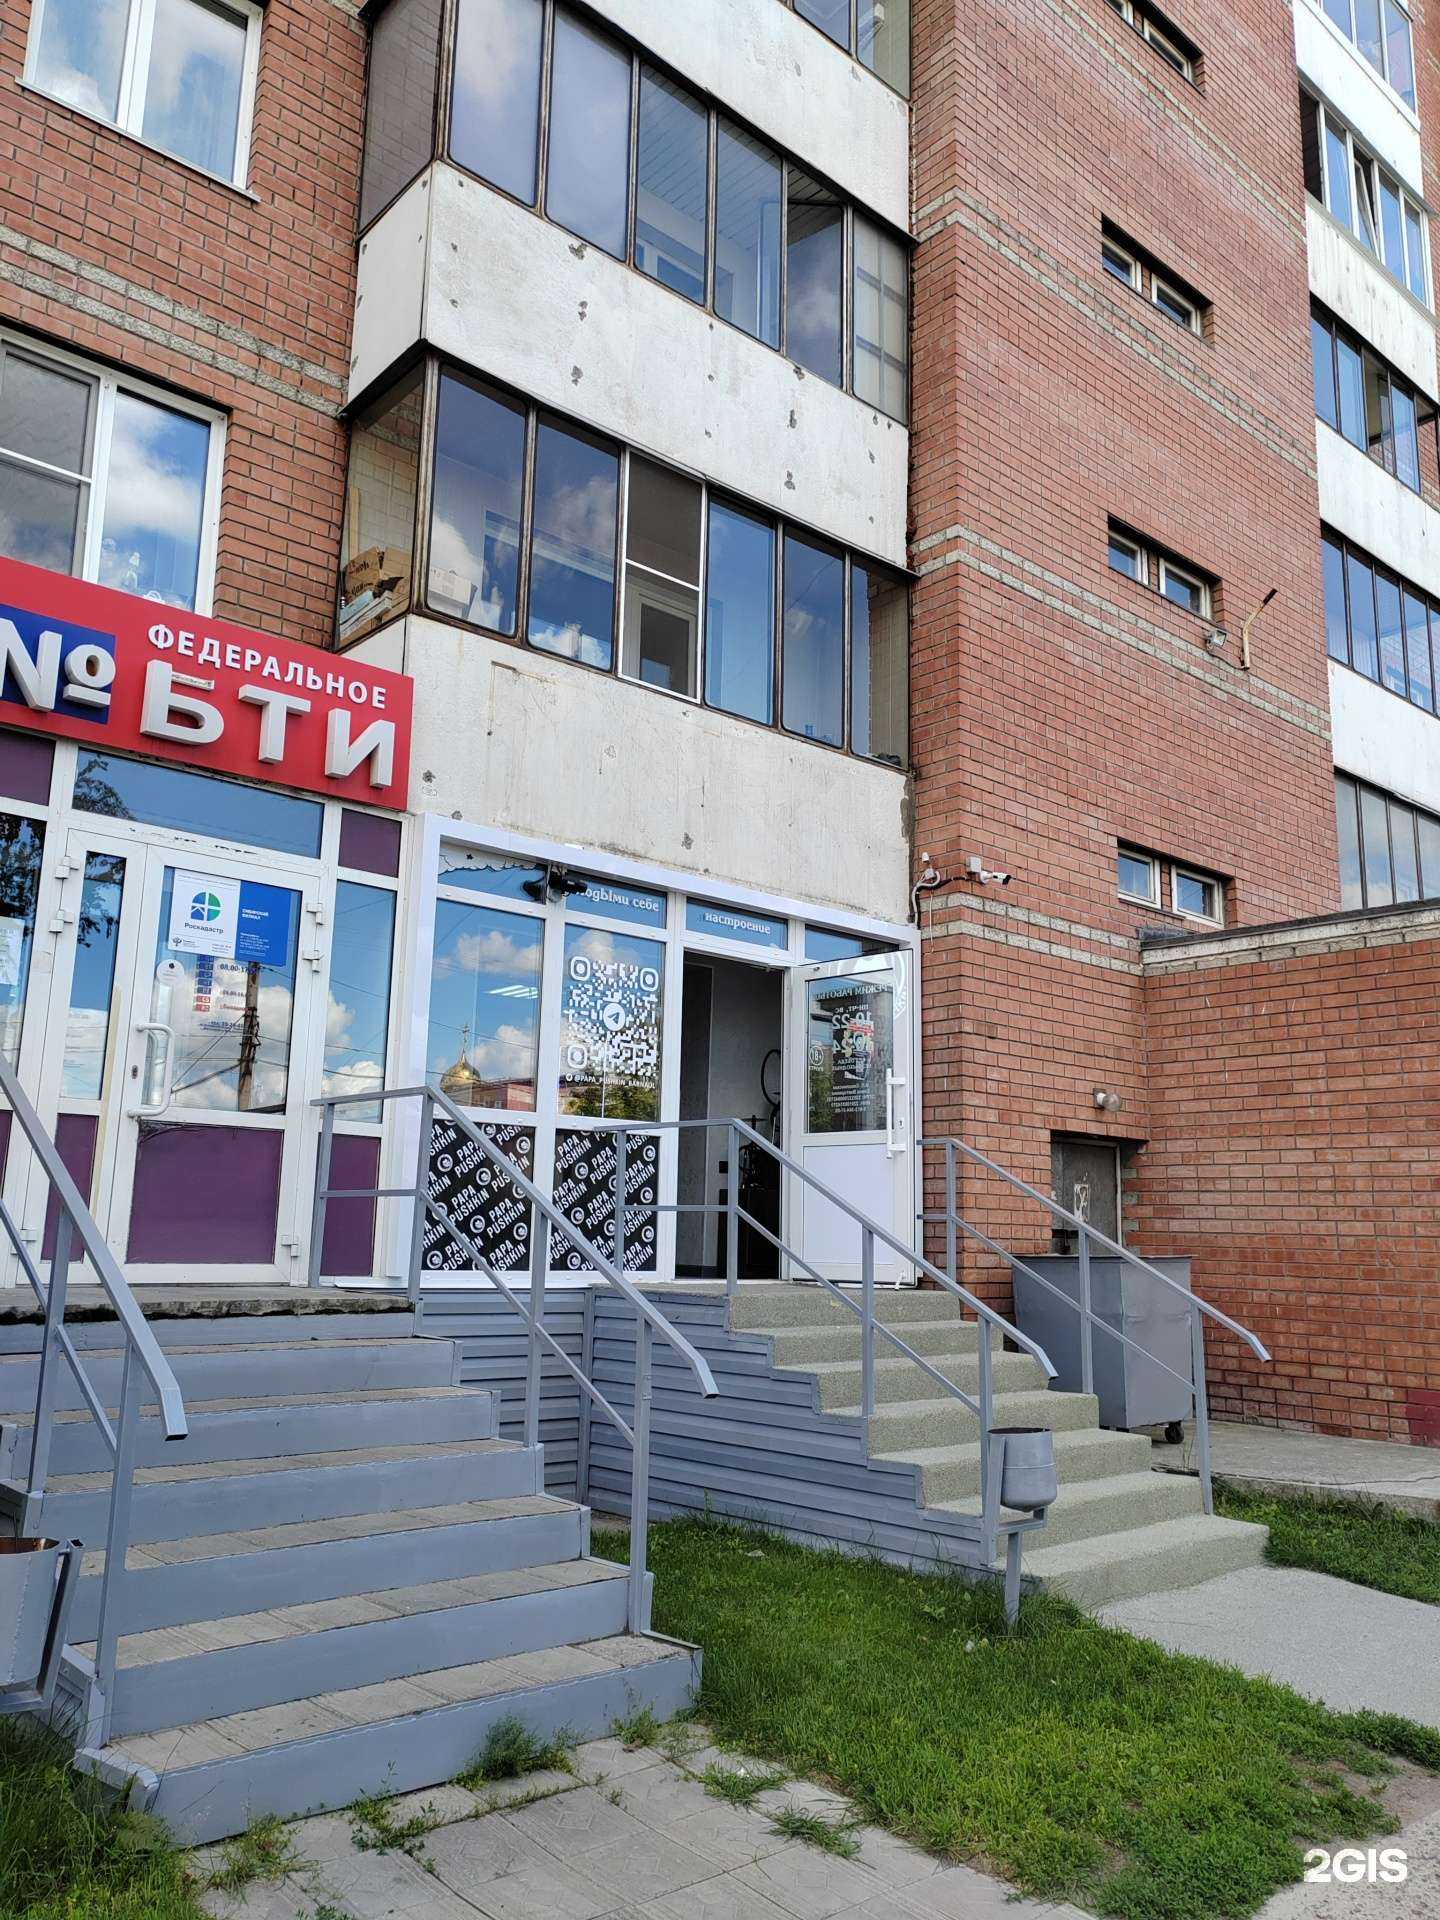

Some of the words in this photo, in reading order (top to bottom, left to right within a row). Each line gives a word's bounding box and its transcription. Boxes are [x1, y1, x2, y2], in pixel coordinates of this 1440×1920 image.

[147, 623, 387, 709] ФЕДЕРАЛЬНОЕ
[140, 659, 395, 789] БТИ
[632, 897, 660, 912] себе
[184, 922, 224, 934] Роскадастр
[703, 911, 771, 935] настроение
[430, 1128, 457, 1156] SHKIN
[557, 1134, 580, 1158] PAPA
[454, 1148, 487, 1178] PUSHK
[555, 1138, 592, 1174] PUSHKIN
[589, 1153, 617, 1185] PUSHK
[591, 1146, 613, 1169] PAPA
[624, 1159, 645, 1182] PAPA
[427, 1174, 452, 1200] HKIN
[451, 1184, 477, 1210] PAPA
[553, 1178, 576, 1202] PAPA
[555, 1181, 588, 1213] USHKIN
[449, 1187, 490, 1226] PUSHKIN
[488, 1197, 513, 1222] PAPA
[587, 1190, 610, 1214] PAPA
[486, 1200, 526, 1239] PUSHKIN
[624, 1210, 653, 1237] USHKIN
[423, 1222, 447, 1249] HKIN
[442, 1235, 484, 1271] PUSHIN
[489, 1239, 514, 1265] PAPA
[492, 1242, 527, 1271] USHKIN
[548, 1238, 574, 1264] PUSH
[624, 1244, 654, 1271] USHKIN
